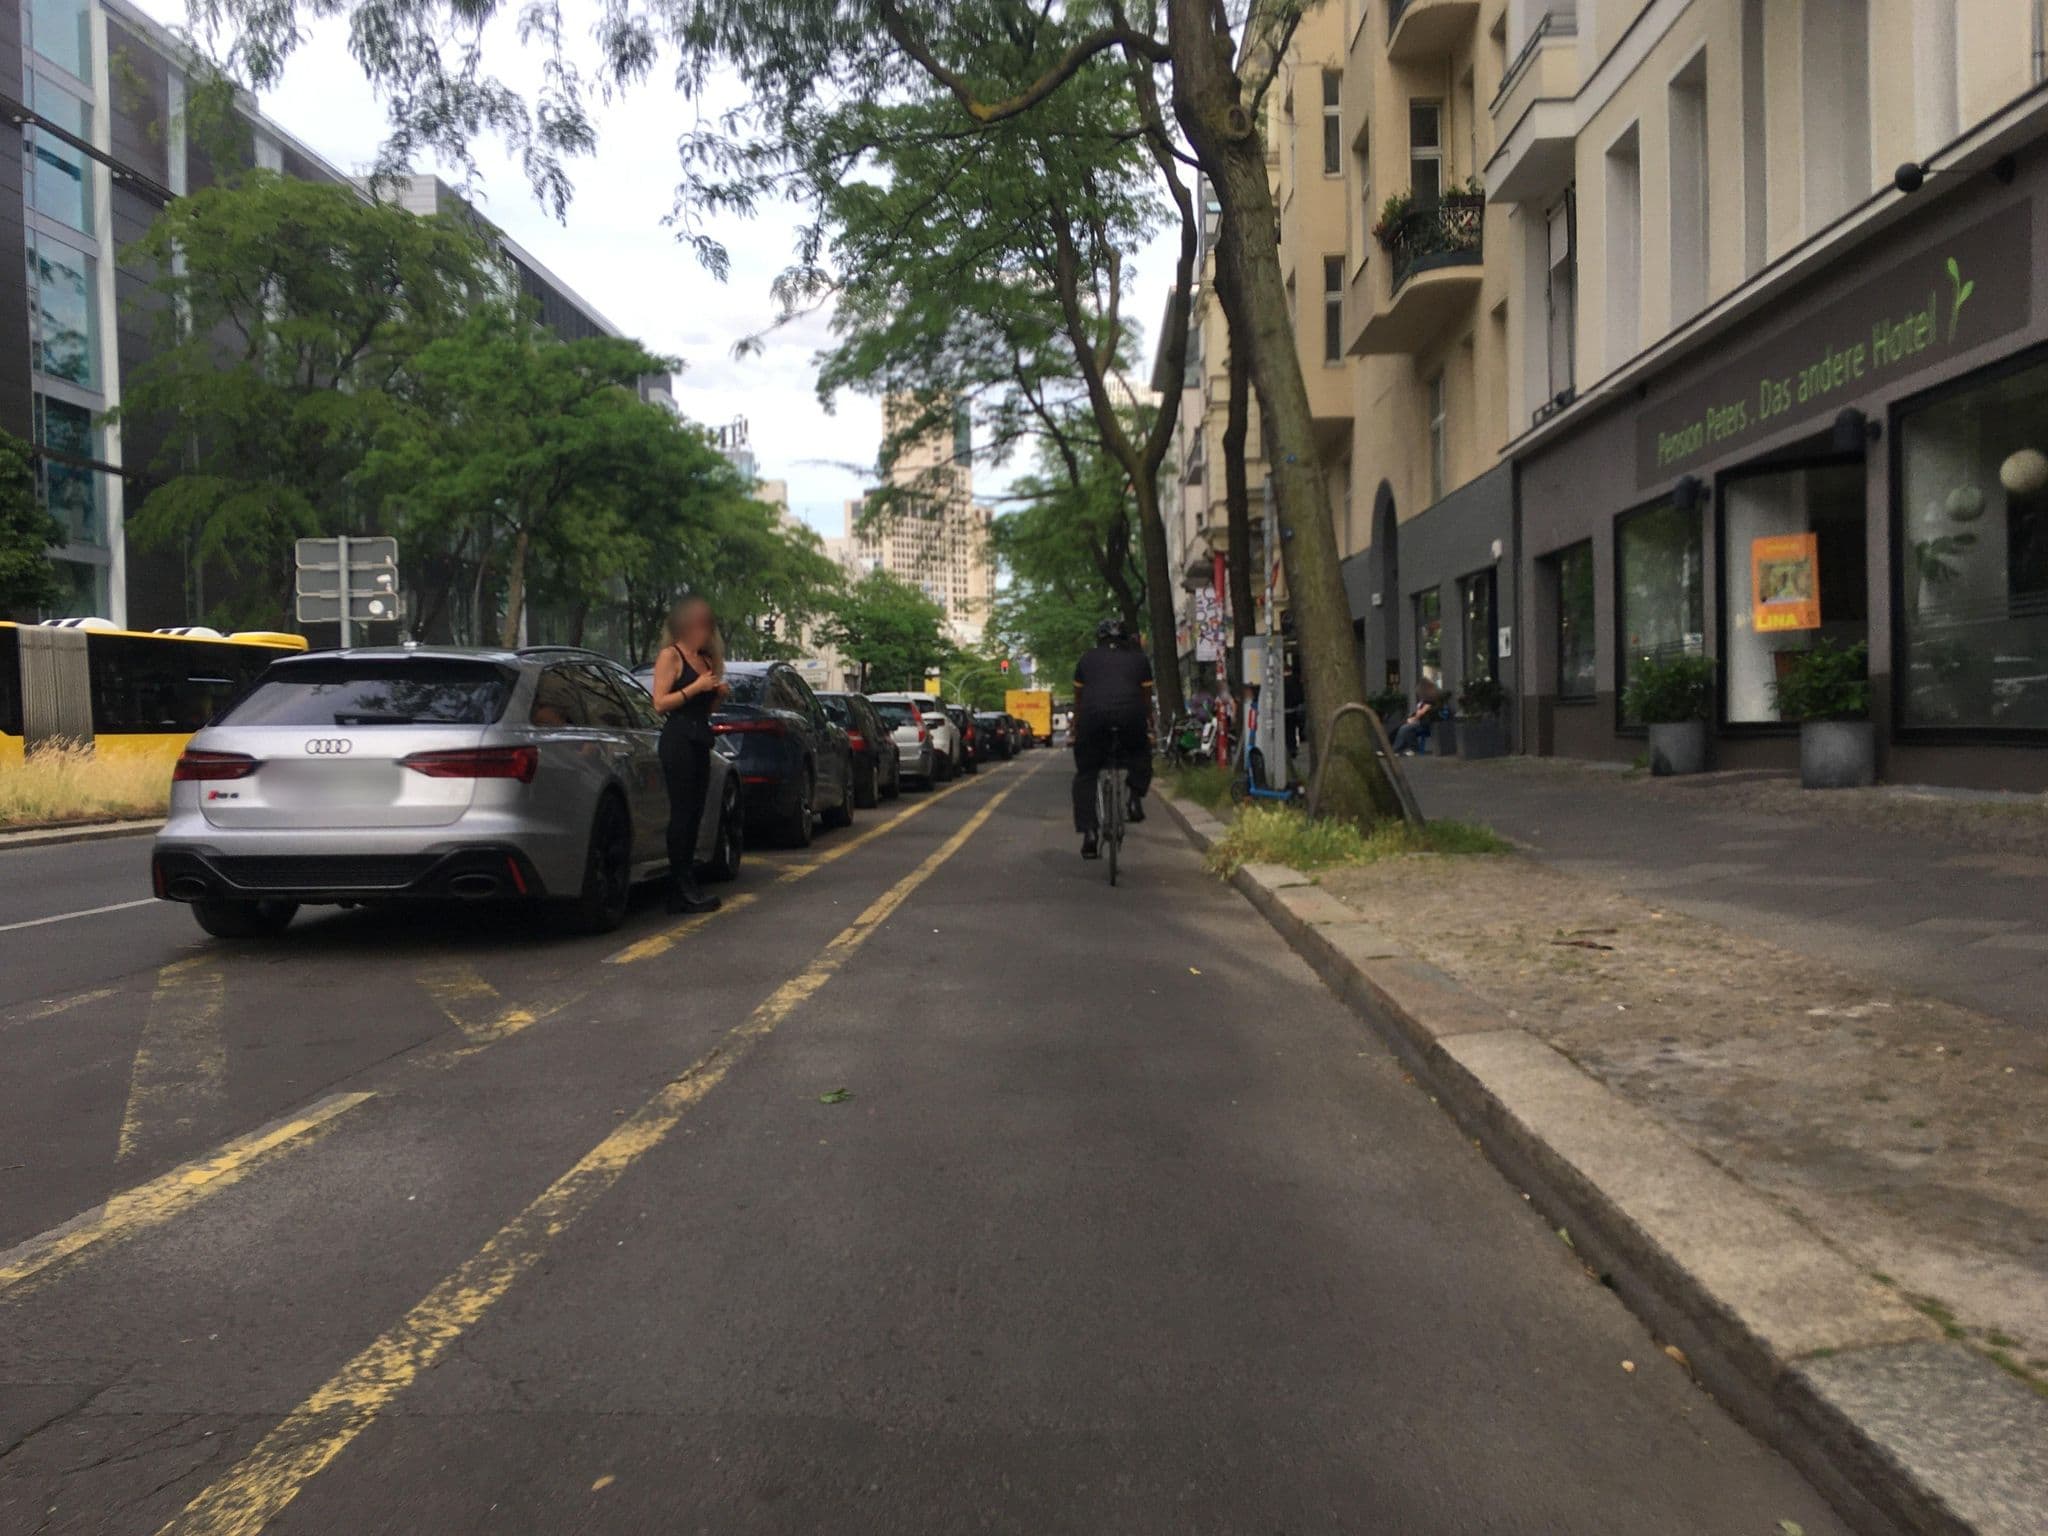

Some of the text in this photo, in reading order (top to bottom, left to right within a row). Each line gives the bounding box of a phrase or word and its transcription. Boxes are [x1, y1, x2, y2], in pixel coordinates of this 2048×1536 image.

[1658, 422, 1704, 468] Pension
[1760, 378, 1792, 420] Das
[1798, 342, 1865, 404] andere
[1872, 289, 1937, 369] Hotel
